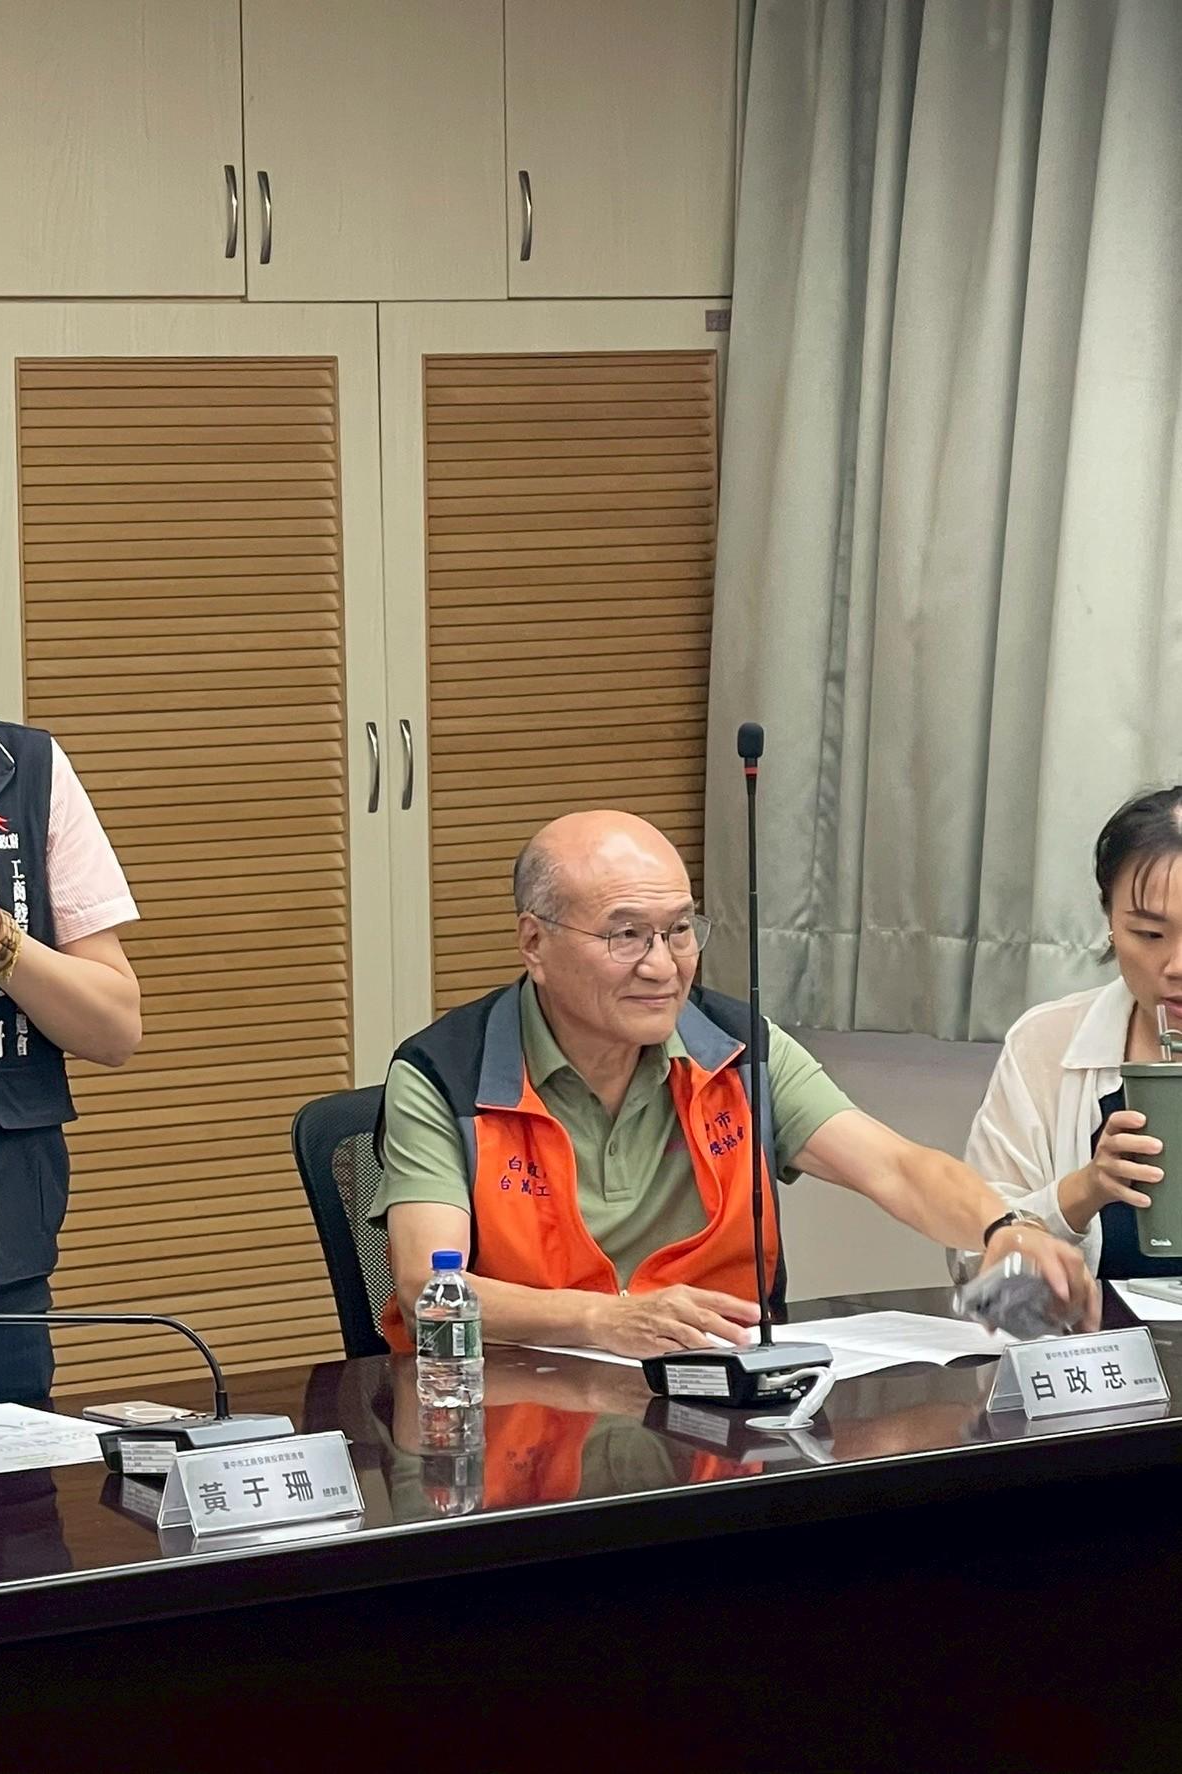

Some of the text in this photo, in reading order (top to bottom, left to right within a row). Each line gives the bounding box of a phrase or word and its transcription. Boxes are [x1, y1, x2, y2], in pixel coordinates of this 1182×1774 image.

[1030, 1361, 1127, 1401] 白政忠
[198, 1469, 314, 1515] 黃于珊
